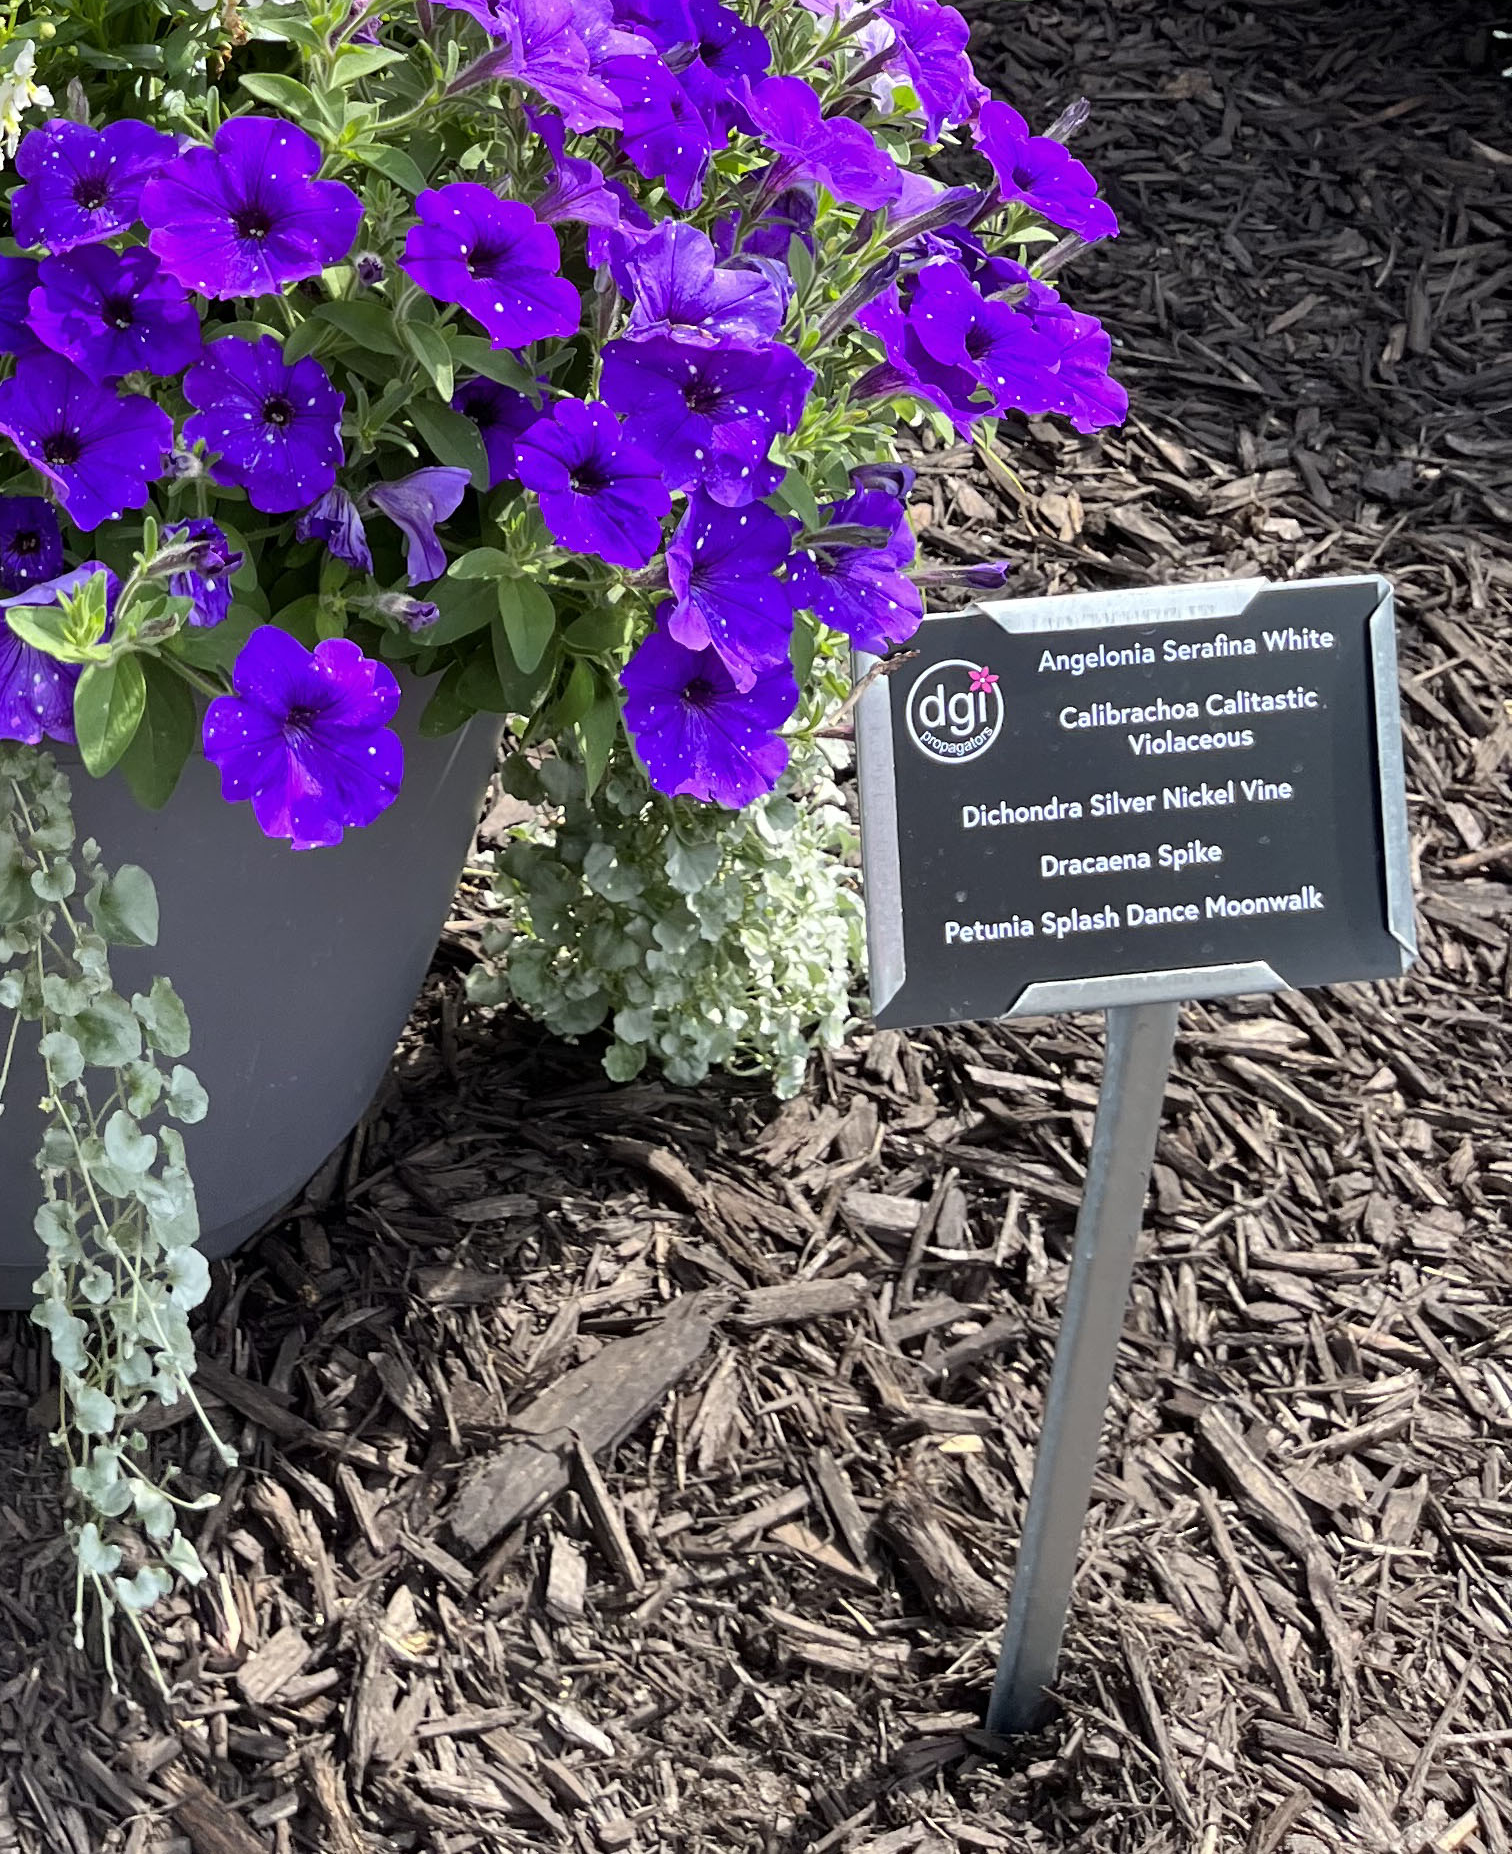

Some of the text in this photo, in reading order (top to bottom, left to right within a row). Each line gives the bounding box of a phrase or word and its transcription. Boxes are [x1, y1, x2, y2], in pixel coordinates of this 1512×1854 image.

[1037, 627, 1337, 677] Angelonia Serafina White
[919, 683, 988, 737] dgi
[1059, 686, 1319, 730] Calibrachoa Calitastic
[919, 726, 993, 756] propagators
[1127, 729, 1255, 756] Violaceous
[962, 778, 1294, 829] Dichondra Silver Nickel Vine
[1040, 839, 1223, 878] Dracaena Spike
[944, 885, 1325, 945] Petunia Splash Dance Moonwalk
